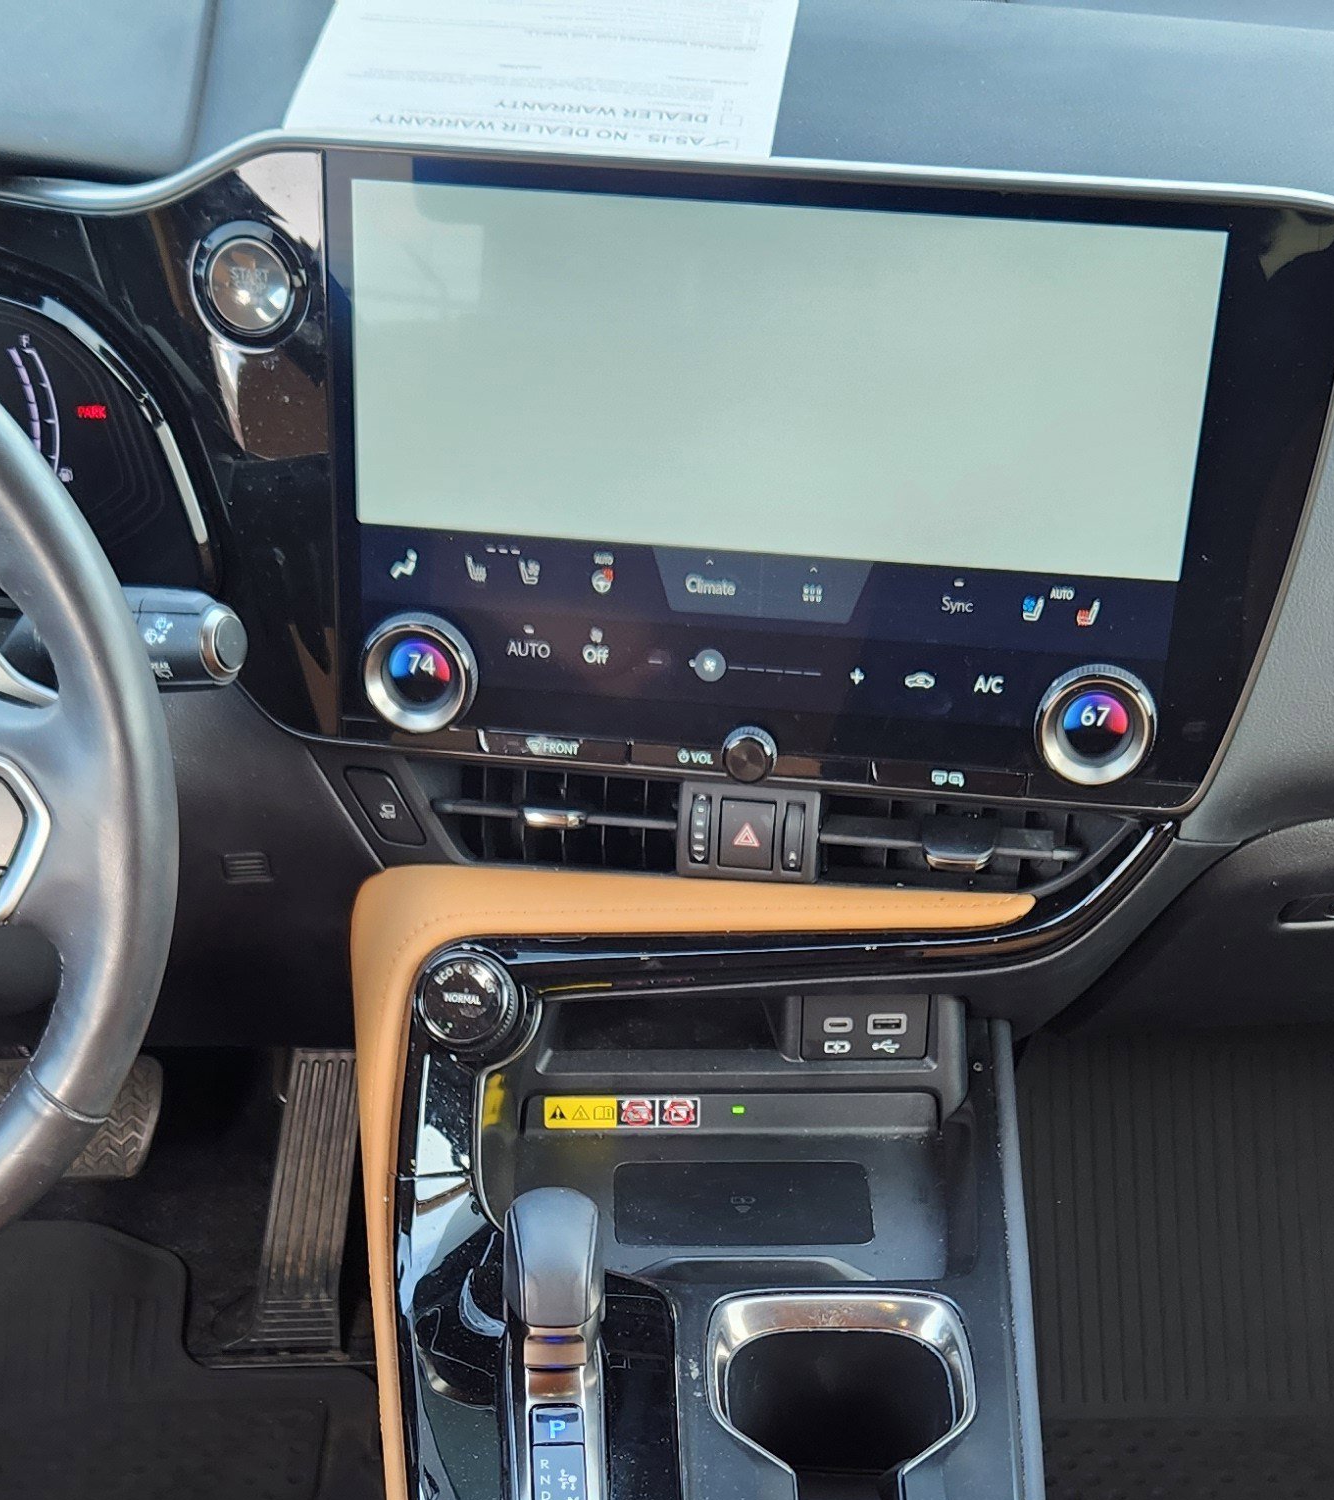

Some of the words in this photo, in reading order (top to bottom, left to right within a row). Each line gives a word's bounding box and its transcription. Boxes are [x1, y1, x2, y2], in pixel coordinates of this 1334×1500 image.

[495, 100, 616, 117] WARRANTY
[623, 108, 708, 123] DEALER
[370, 114, 495, 131] WARRANTY
[502, 122, 589, 138] DEALER
[596, 129, 628, 141] NO
[77, 405, 107, 418] PARK
[685, 574, 736, 596] Climate
[1050, 587, 1074, 600] AUTO
[941, 596, 974, 614] Sync
[507, 641, 551, 658] AUTO
[583, 645, 609, 665] Off
[408, 654, 436, 676] 74
[974, 675, 1004, 693] A/C
[1080, 705, 1110, 727] 67
[542, 743, 580, 755] FRONT
[691, 752, 714, 765] VOL
[433, 967, 454, 985] ECO
[443, 991, 481, 1005] NORMAL
[549, 1420, 566, 1438] P
[540, 1459, 550, 1469] R
[540, 1475, 551, 1485] N
[541, 1491, 551, 1500] D
